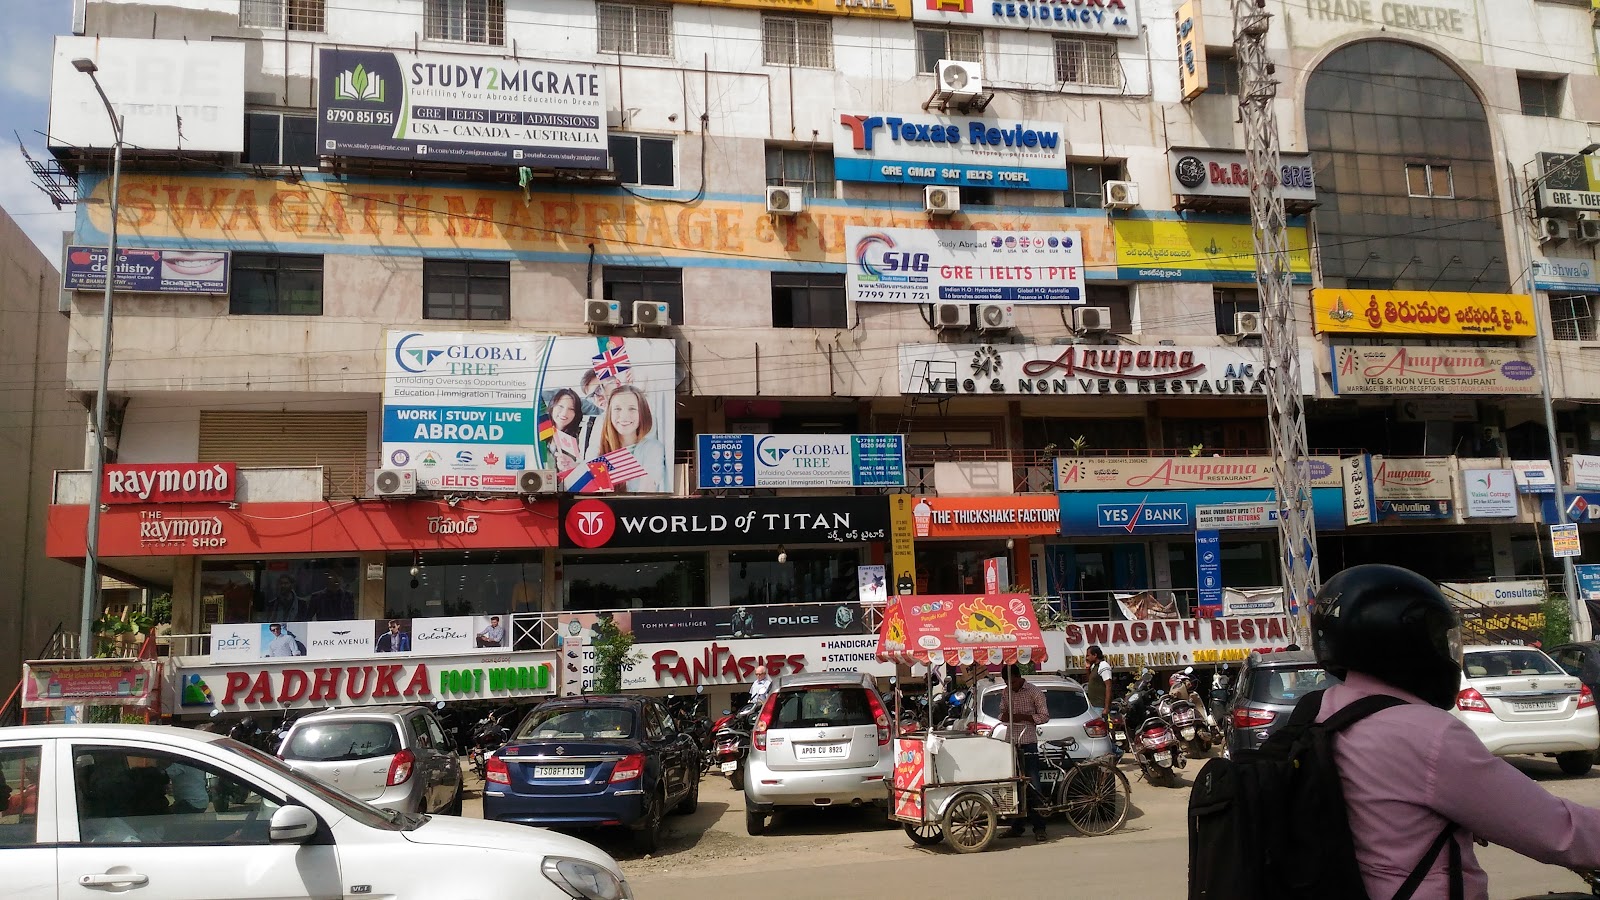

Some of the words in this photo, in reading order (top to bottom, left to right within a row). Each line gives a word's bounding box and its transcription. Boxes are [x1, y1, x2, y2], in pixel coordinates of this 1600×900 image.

[991, 2, 1104, 24] RESIDENCY
[1304, 0, 1373, 25] TRADE
[1381, 2, 1464, 33] CENTRE
[411, 62, 599, 97] STUDY2MIGRATE
[411, 88, 457, 99] Fulfilling
[461, 90, 483, 100] Your
[486, 91, 519, 102] Abroad
[522, 94, 569, 105] Education
[572, 96, 600, 106] Dream
[326, 109, 354, 123] 8790
[356, 109, 374, 124] 851
[375, 110, 394, 124] 951
[416, 107, 441, 119] GRE
[451, 109, 484, 121] IELTS
[495, 111, 518, 123] PTE
[526, 114, 596, 127] ADMISSIONS
[412, 123, 440, 135] USA
[453, 125, 511, 139] CANADA
[522, 129, 600, 143] AUSTRALIA
[886, 117, 960, 144] Texas
[969, 121, 1058, 149] Review
[881, 165, 903, 177] GRE
[907, 166, 936, 178] GMAT
[941, 168, 962, 179] SAT
[966, 169, 993, 181] IELTS
[998, 171, 1029, 182] TOEFL
[1281, 164, 1313, 188] GRE
[1552, 191, 1572, 205] GRE
[115, 182, 434, 237] SWAGATH
[443, 194, 745, 252] MARRIAGE
[937, 240, 957, 249] Study
[958, 240, 988, 249] Abroad
[90, 253, 127, 265] aple
[882, 251, 930, 272] SIG
[940, 265, 973, 280] GRE
[989, 265, 1033, 280] IELTS
[1048, 266, 1077, 280] PTE
[858, 290, 884, 299] 7799
[888, 291, 906, 299] 771
[911, 292, 930, 300] 721
[1384, 300, 1451, 324] తిరుమల
[447, 344, 527, 361] GLOBAL
[446, 361, 500, 377] TREE
[1023, 346, 1205, 380] Anupama
[1225, 362, 1254, 377] A/C
[1365, 347, 1493, 377] Anupama
[395, 376, 434, 387] Unfolding
[435, 377, 472, 387] Overseas
[472, 378, 527, 389] Opportunities
[925, 378, 975, 393] VEG
[990, 379, 1005, 392] &
[1018, 379, 1068, 393] NON
[1078, 379, 1126, 393] VEG
[1136, 379, 1265, 394] RESTAURA
[1438, 378, 1496, 386] RESTAURANT
[394, 388, 435, 398] Education
[440, 389, 489, 400] Immigration
[495, 390, 527, 401] Training
[397, 409, 437, 422] WORK
[445, 410, 487, 422] STUDY
[495, 411, 522, 423] LIVE
[413, 423, 504, 441] ABROAD
[792, 444, 849, 455] GLOBAL
[792, 457, 831, 468] TREE
[441, 475, 479, 487] IELTS
[757, 469, 785, 477] Unfolding
[812, 469, 851, 478] Opportunities
[1127, 459, 1265, 487] Anupama
[1374, 461, 1433, 487] Anupama
[107, 464, 228, 500] Raymond
[790, 479, 824, 487] Immigration
[828, 479, 851, 487] Training
[140, 510, 162, 519] THE
[1103, 509, 1129, 521] YES
[1144, 509, 1183, 521] BANK
[1390, 502, 1431, 512] Valvoline
[620, 514, 728, 533] WORLD
[734, 511, 759, 533] of
[762, 511, 852, 531] TITAN
[931, 510, 952, 524] THE
[952, 508, 1016, 524] THICKSHAKE
[1017, 508, 1061, 523] FACTORY
[140, 516, 223, 542] Raymond
[192, 538, 227, 547] SHOP
[1494, 587, 1545, 599] Consultanc
[641, 622, 670, 630] TOMMY
[677, 620, 708, 629] HILFIGER
[768, 615, 819, 626] POLICE
[1065, 620, 1200, 645] SWAGATH
[312, 639, 334, 647] PARK
[337, 637, 370, 646] AVENUE
[651, 642, 806, 686] FANTASIES
[1065, 653, 1086, 669] FRE
[1127, 651, 1180, 667] DELIVERY
[221, 662, 432, 706] PADHUKA
[439, 668, 483, 695] FOOT
[488, 665, 550, 692] WORLD
